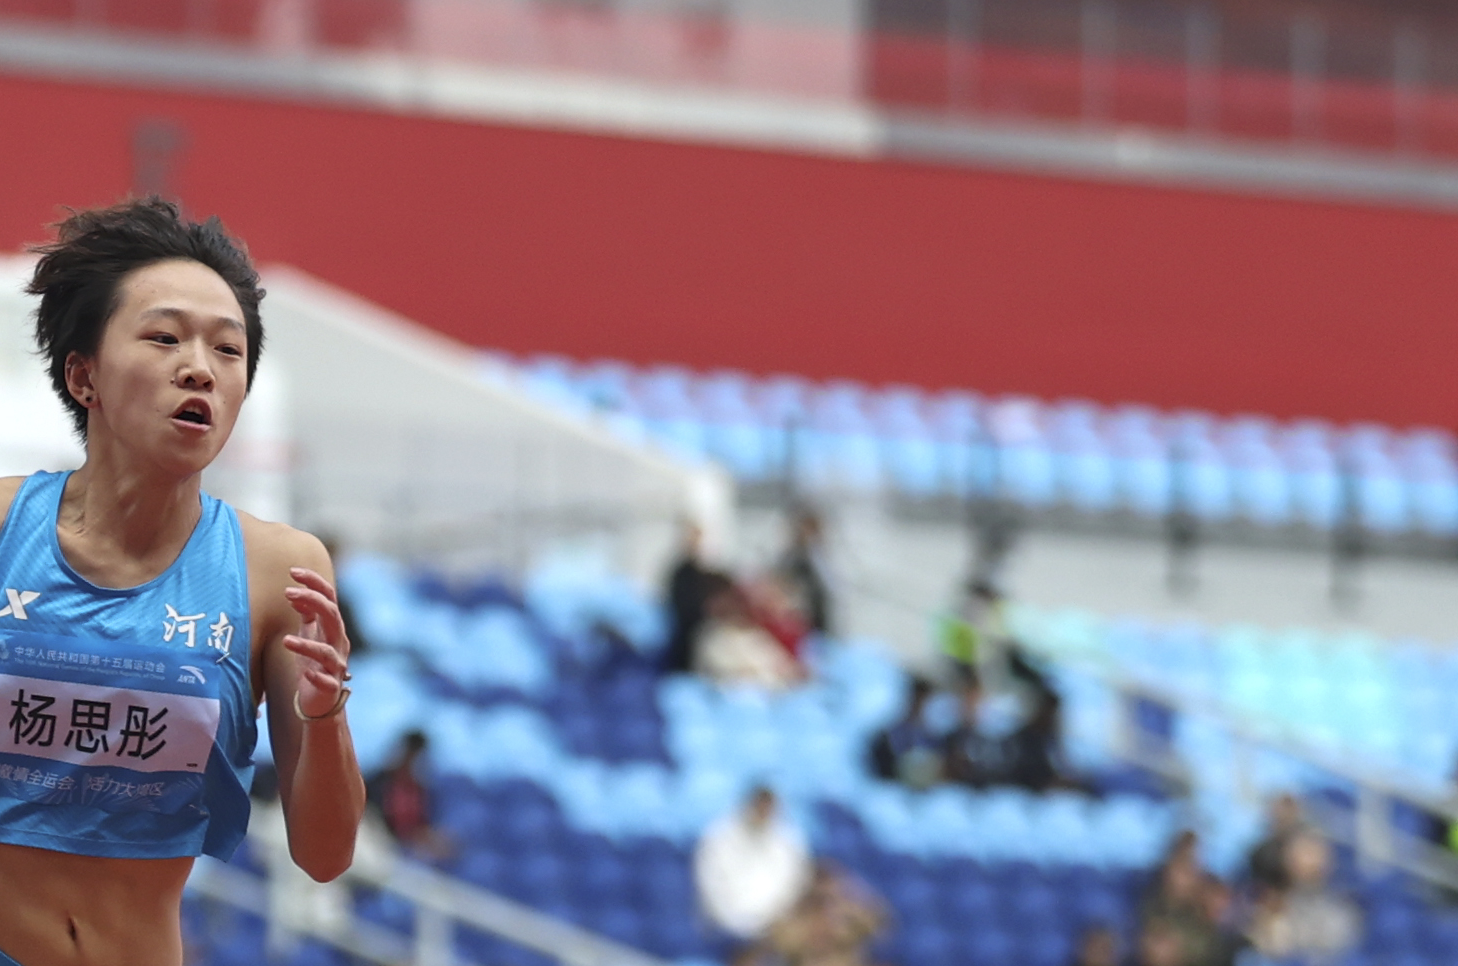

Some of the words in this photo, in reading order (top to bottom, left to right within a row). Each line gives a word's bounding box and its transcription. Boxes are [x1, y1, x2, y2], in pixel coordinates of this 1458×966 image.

[162, 603, 233, 653] 河南
[9, 689, 169, 760] 杨思彤
